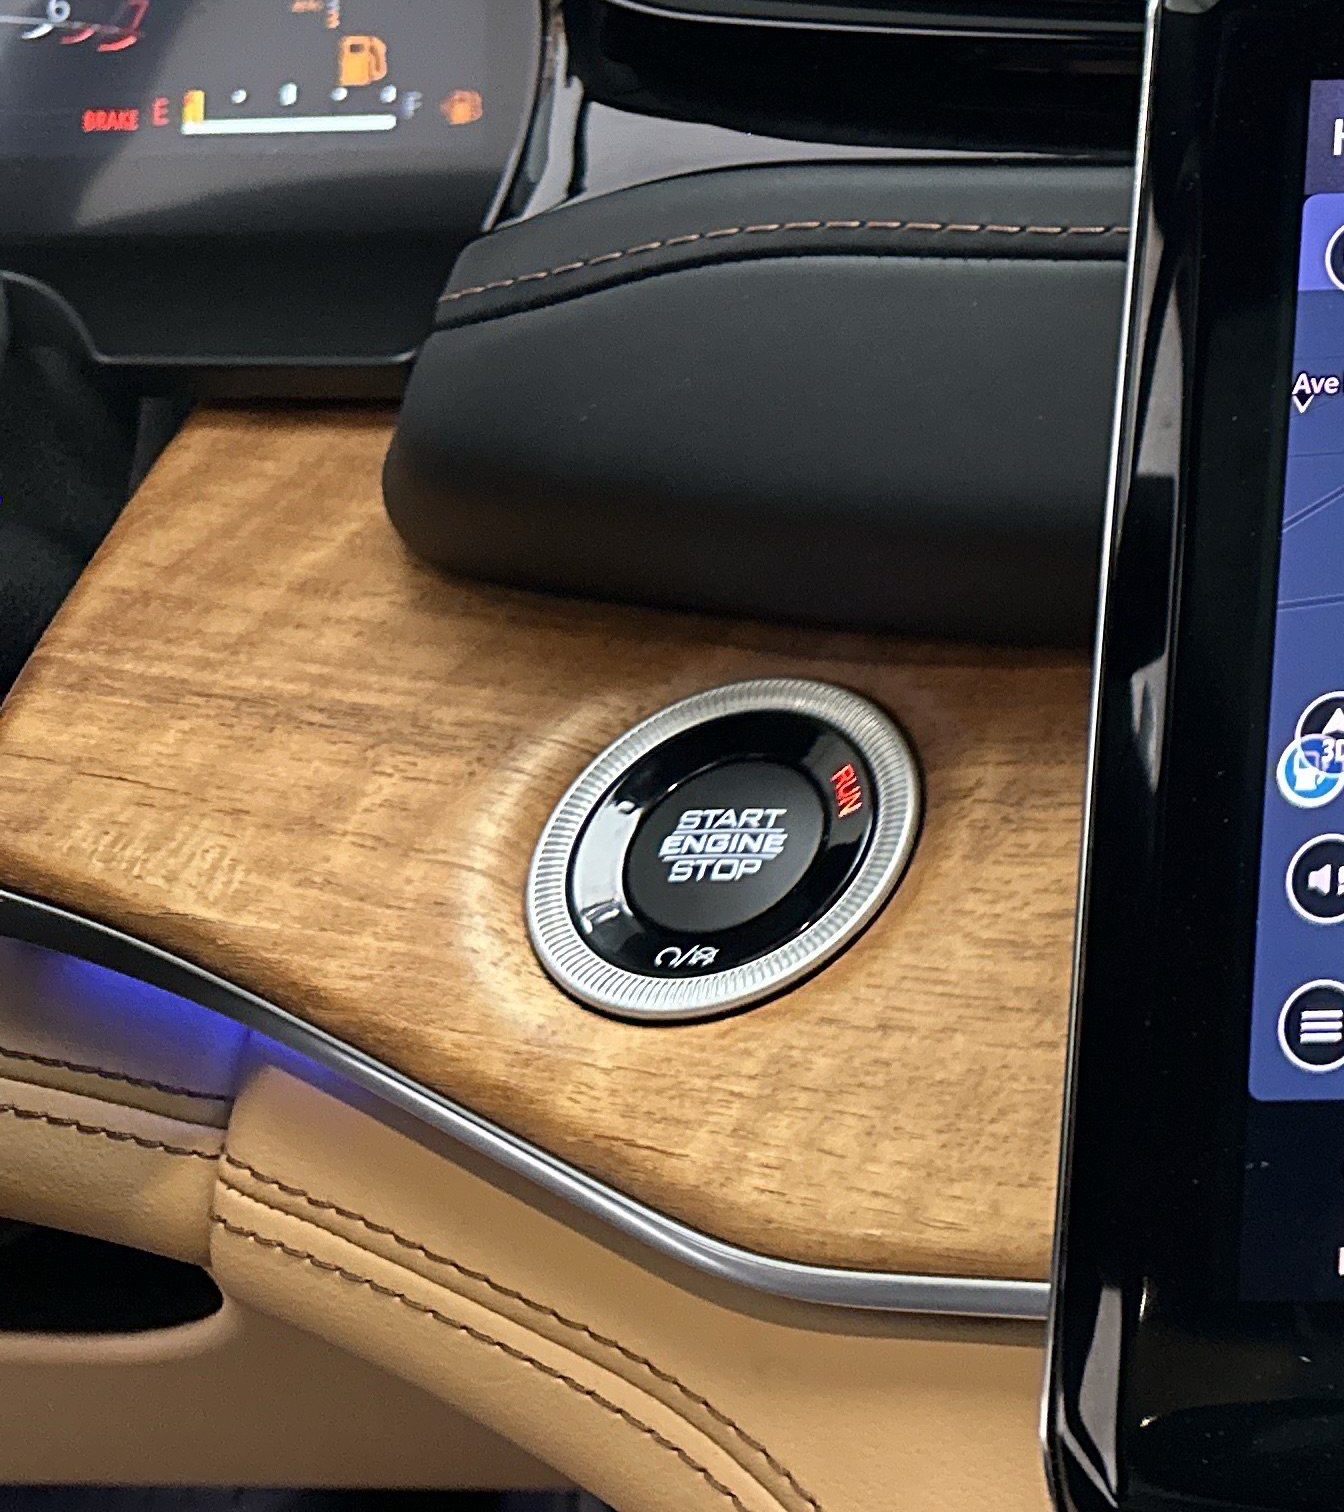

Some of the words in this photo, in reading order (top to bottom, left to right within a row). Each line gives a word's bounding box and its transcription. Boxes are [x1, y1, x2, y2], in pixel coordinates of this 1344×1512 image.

[81, 108, 140, 133] BRAKE
[151, 96, 170, 127] E
[1292, 372, 1340, 394] Ave
[830, 763, 863, 818] RUN
[675, 808, 788, 830] START
[658, 833, 789, 856] ENGINE
[667, 859, 763, 883] STOP
